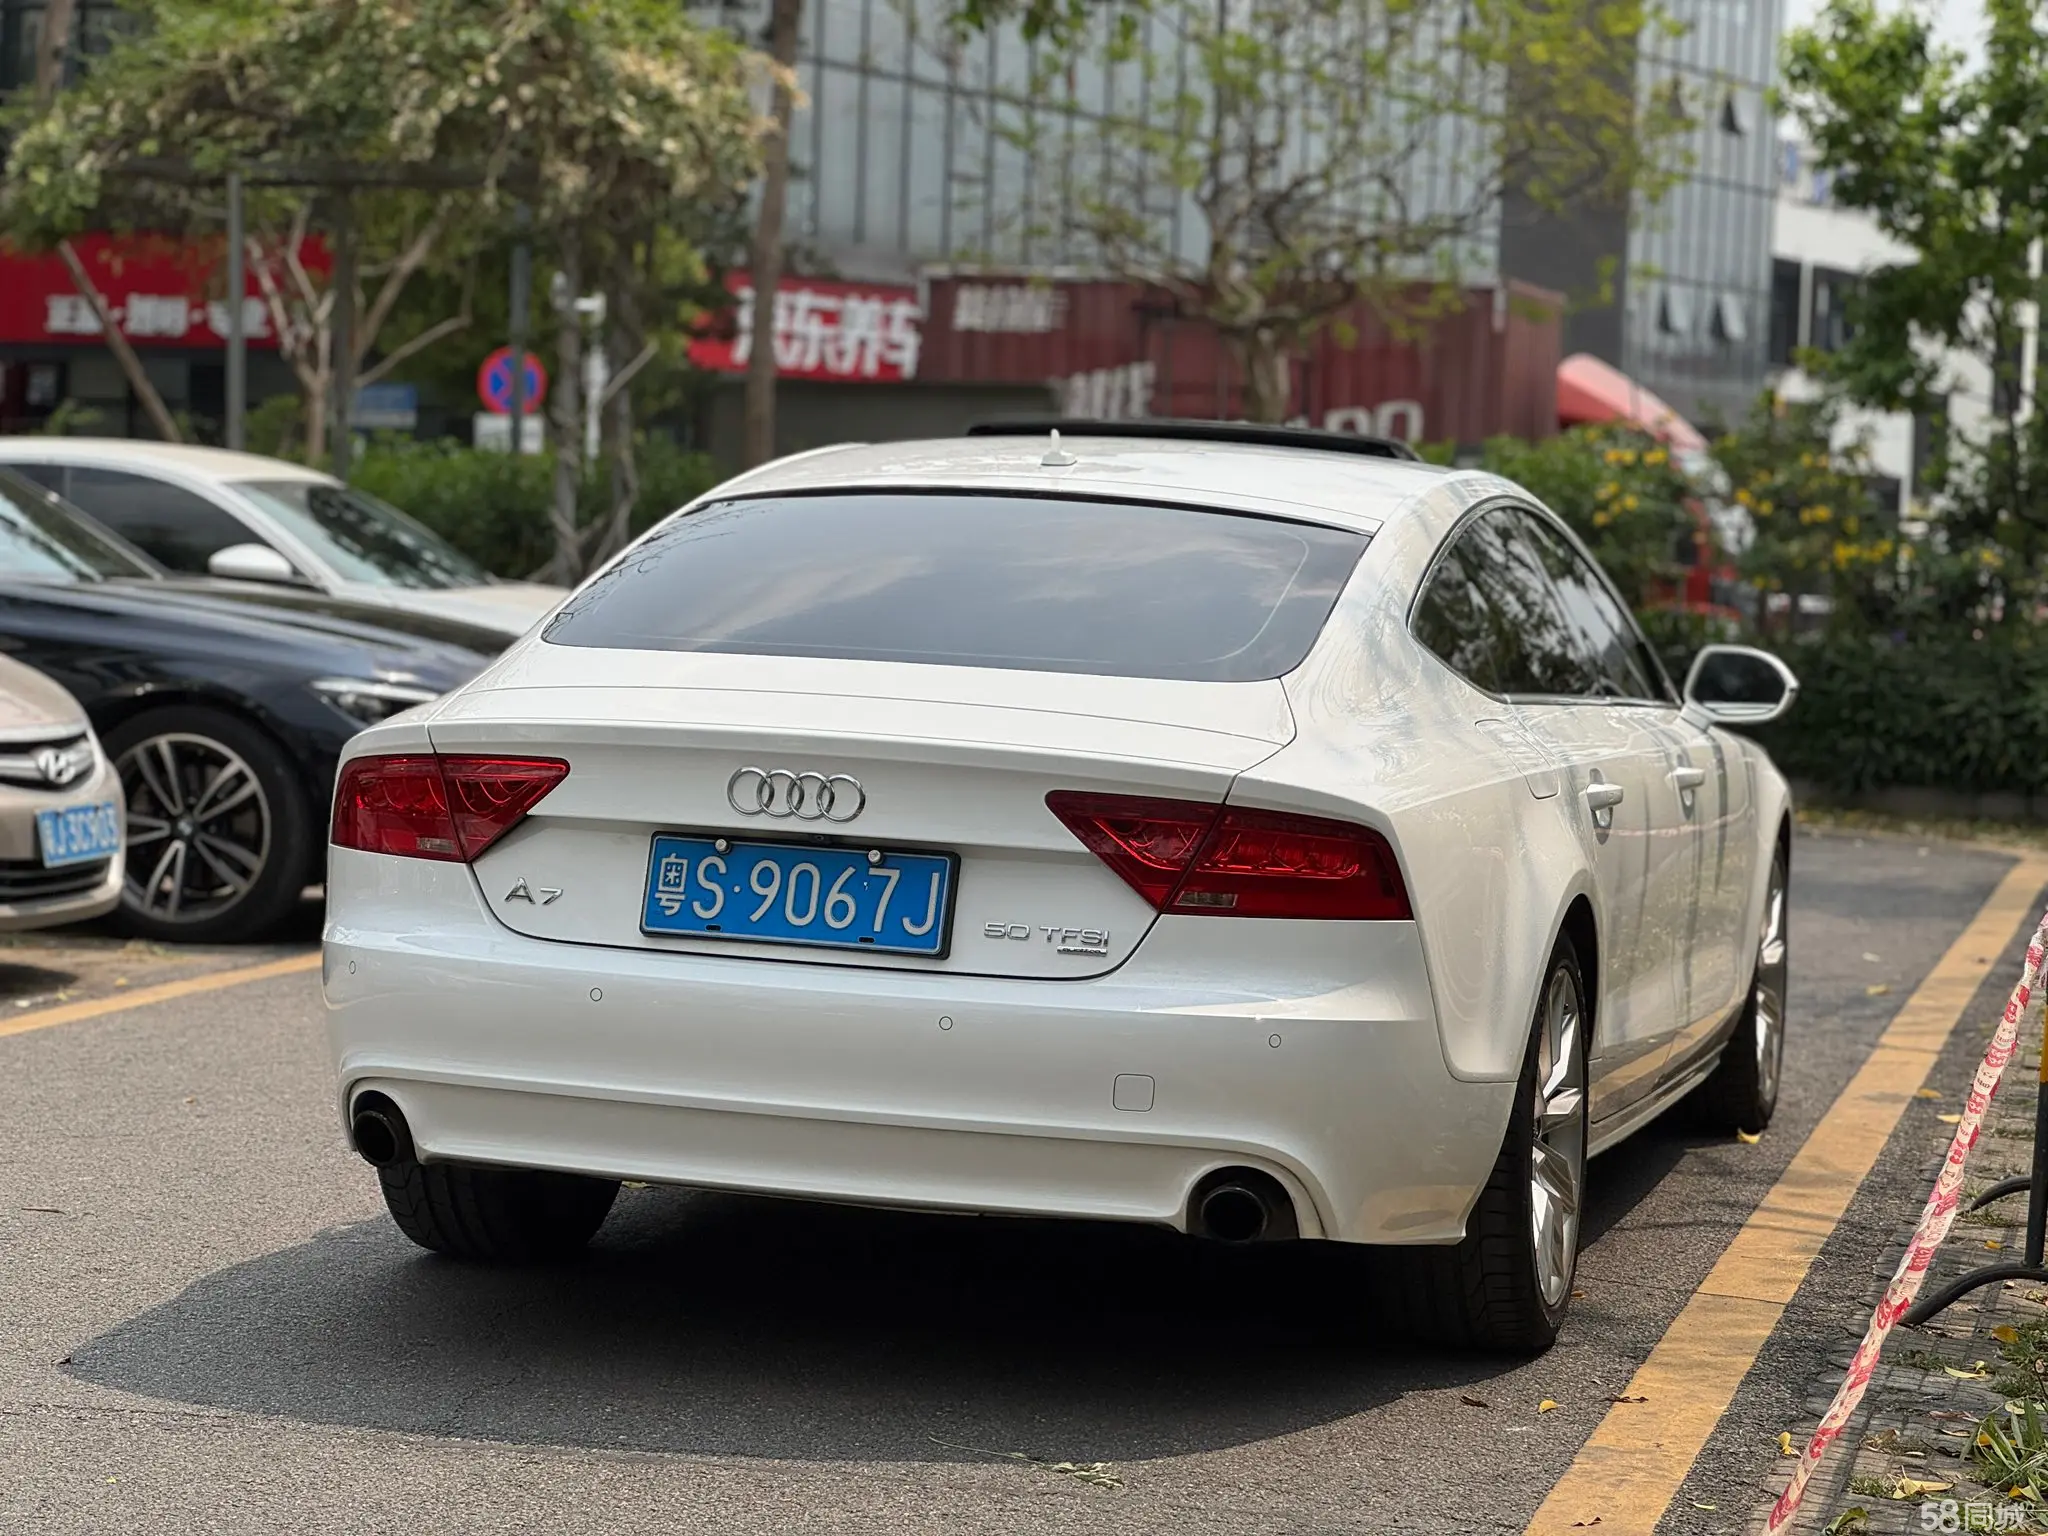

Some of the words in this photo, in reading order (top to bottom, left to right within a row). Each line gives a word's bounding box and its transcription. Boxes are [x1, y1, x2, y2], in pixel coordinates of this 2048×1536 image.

[654, 853, 941, 936] 粤S·9067J
[984, 922, 1030, 941] 50
[1039, 927, 1110, 946] TFSI
